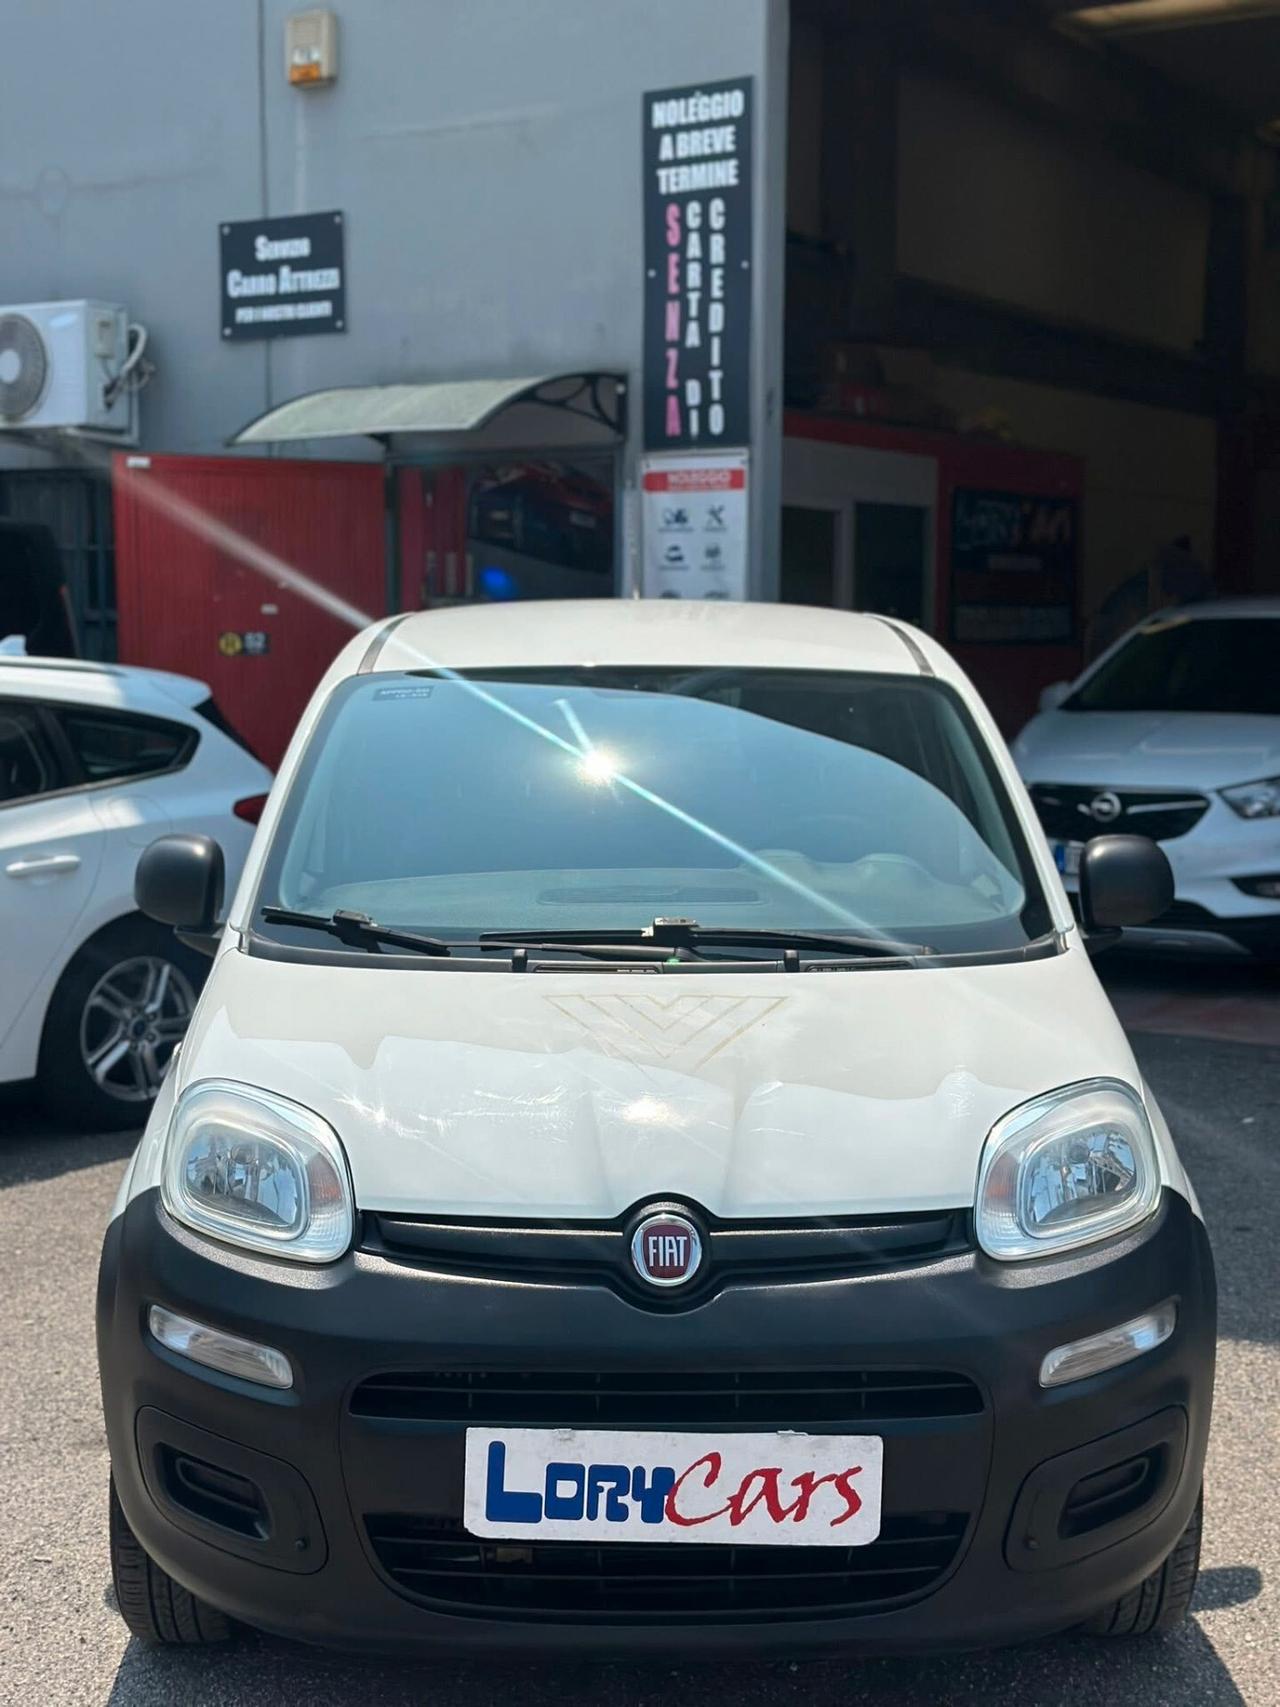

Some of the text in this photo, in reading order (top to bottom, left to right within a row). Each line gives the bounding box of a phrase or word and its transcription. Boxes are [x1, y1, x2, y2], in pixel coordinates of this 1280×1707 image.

[656, 157, 739, 195] TERMINE
[658, 124, 737, 161] A BREVE
[665, 202, 682, 437] SENZA
[684, 200, 703, 438] CARTA DI
[708, 197, 726, 436] CREDITO
[648, 1236, 688, 1267] FIAT
